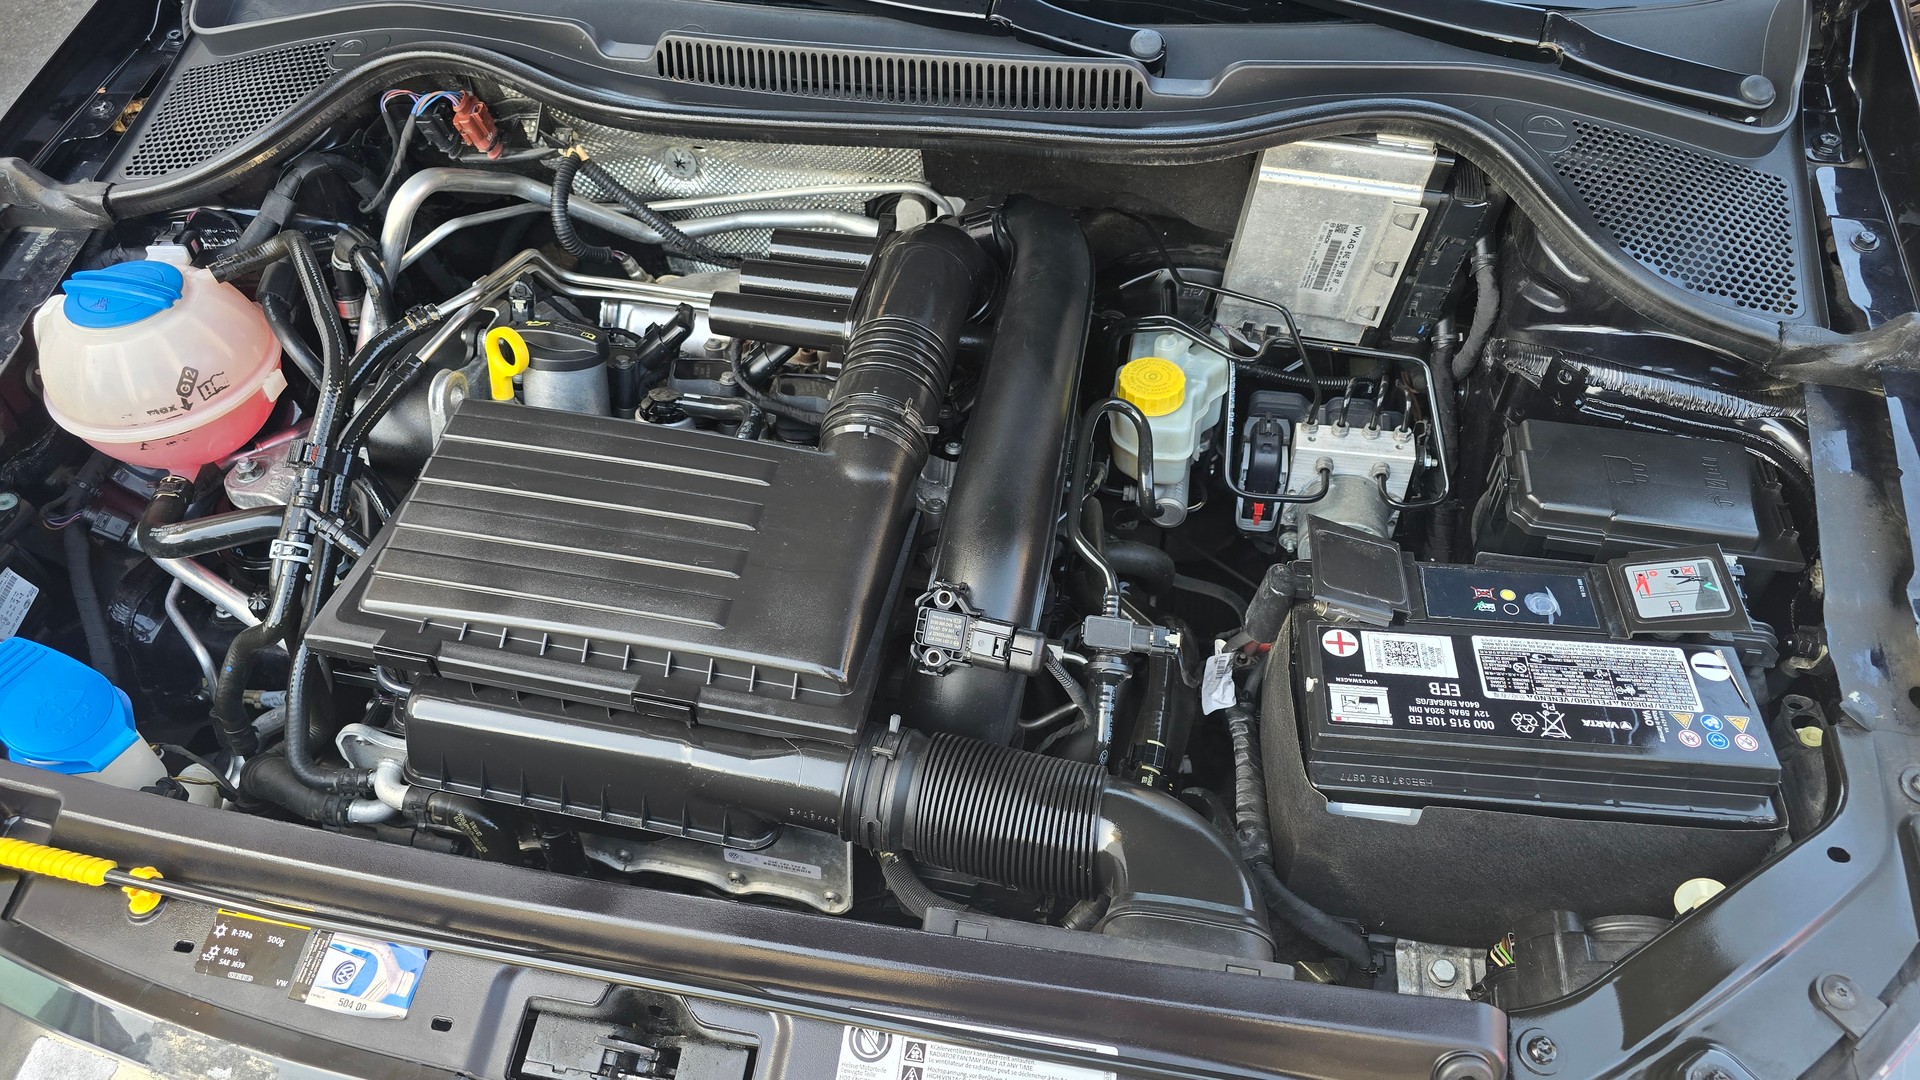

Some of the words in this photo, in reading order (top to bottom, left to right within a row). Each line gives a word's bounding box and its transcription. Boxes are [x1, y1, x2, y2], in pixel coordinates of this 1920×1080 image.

[1323, 229, 1334, 244] BOSCH
[1352, 225, 1363, 238] VW
[1346, 238, 1357, 250] AG
[180, 369, 196, 394] G12
[1335, 676, 1378, 685] VOLKSWAGEN
[1428, 681, 1461, 697] EFB
[1415, 697, 1458, 707] EN/SAE/GS
[1458, 700, 1480, 709] 640A
[1542, 702, 1556, 711] Pb
[1409, 705, 1423, 714] DIN
[1424, 706, 1445, 715] 320A
[1449, 708, 1470, 717] 59Ah
[1474, 710, 1490, 718] 12V
[1408, 715, 1423, 725] EB
[1425, 716, 1447, 727] 105
[1449, 717, 1471, 728] 915
[1581, 719, 1620, 729] VARTA
[1642, 710, 1655, 727] VAO
[1474, 719, 1495, 730] 000
[231, 928, 253, 940] R-134a
[267, 935, 286, 948] 500g
[223, 946, 239, 956] PAG
[218, 958, 230, 967] SAE
[231, 960, 246, 969] J639
[276, 978, 289, 988] VW
[338, 997, 353, 1010] 504
[929, 1050, 956, 1060] RADIATOR
[957, 1054, 968, 1062] FAN
[968, 1056, 982, 1064] MAY
[982, 1057, 998, 1065] START
